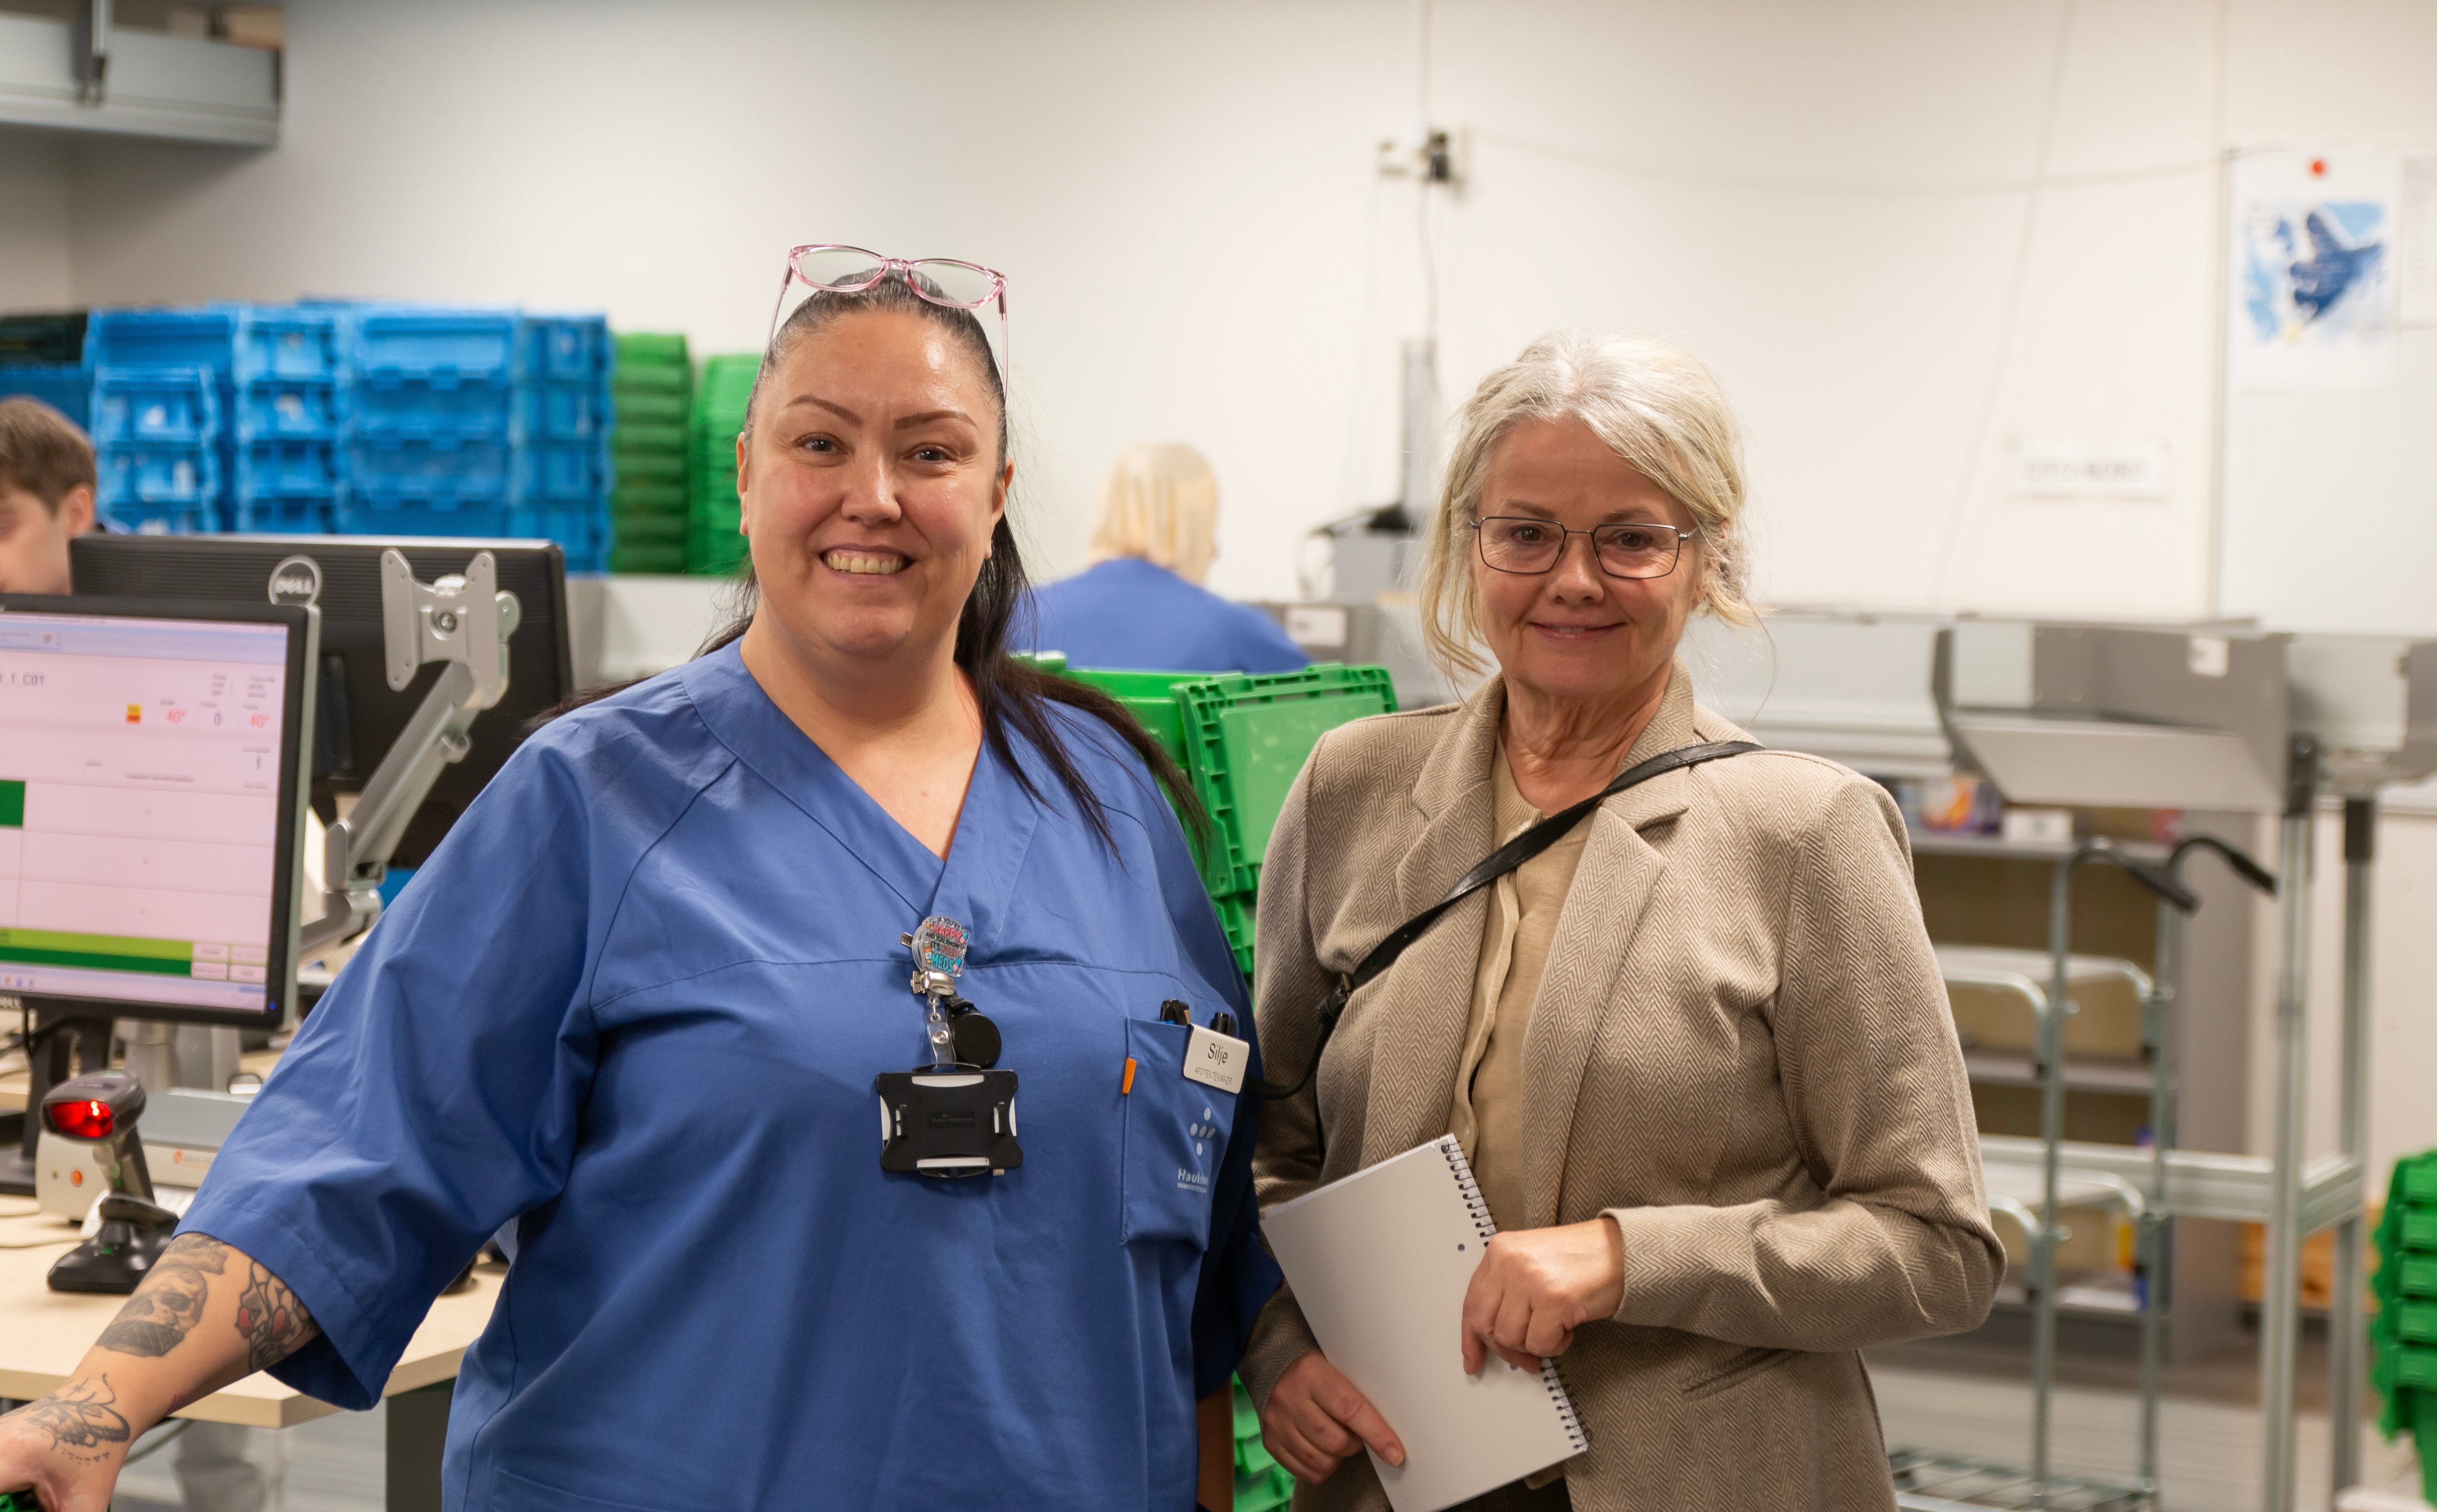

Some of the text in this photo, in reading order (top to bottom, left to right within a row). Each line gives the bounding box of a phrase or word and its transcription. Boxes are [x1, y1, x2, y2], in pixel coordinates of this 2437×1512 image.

[933, 922, 962, 943] HAPPY
[941, 944, 958, 958] YOUR
[930, 952, 954, 974] MEDS
[1208, 1043, 1228, 1065] Silje
[1194, 1067, 1233, 1085] APOTEKTEKNIKER
